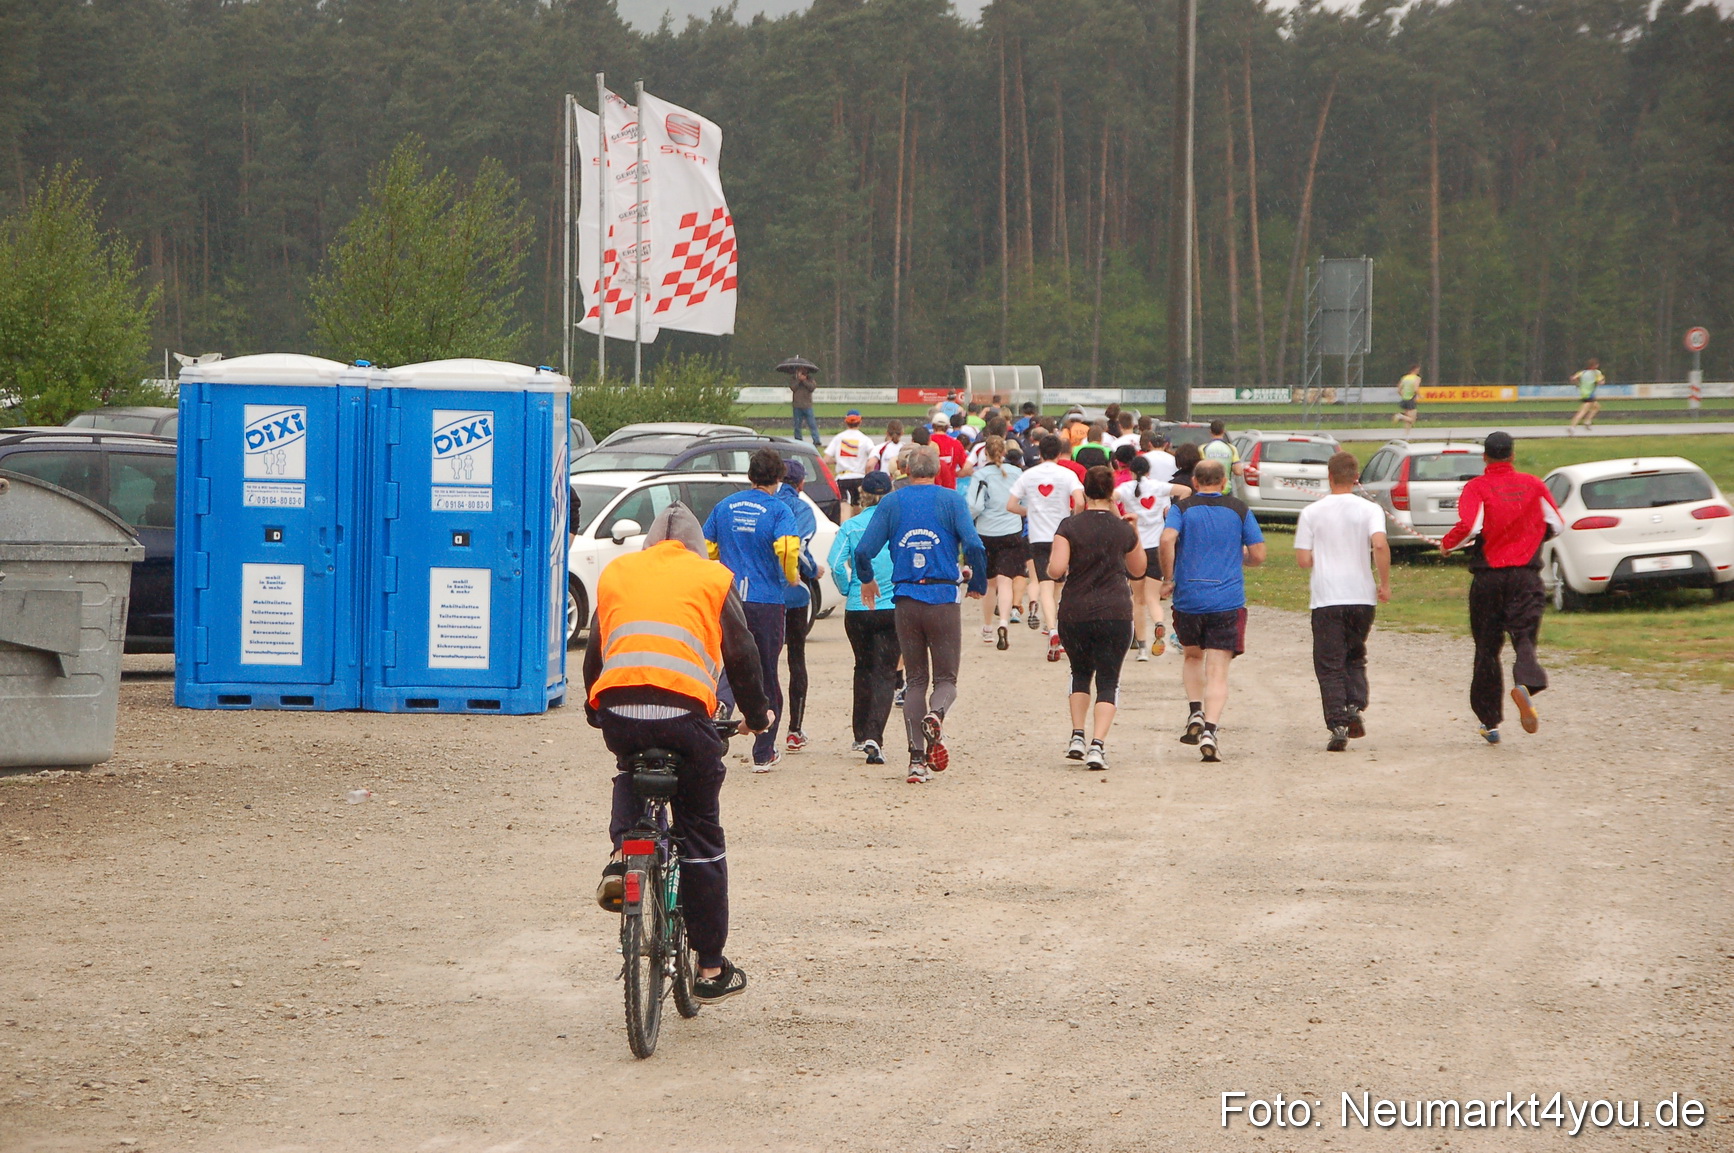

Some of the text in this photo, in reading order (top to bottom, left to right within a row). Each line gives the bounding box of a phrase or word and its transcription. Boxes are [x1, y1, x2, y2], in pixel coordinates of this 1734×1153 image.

[1426, 387, 1496, 398] MAX BÖGL
[898, 528, 940, 547] funrunners
